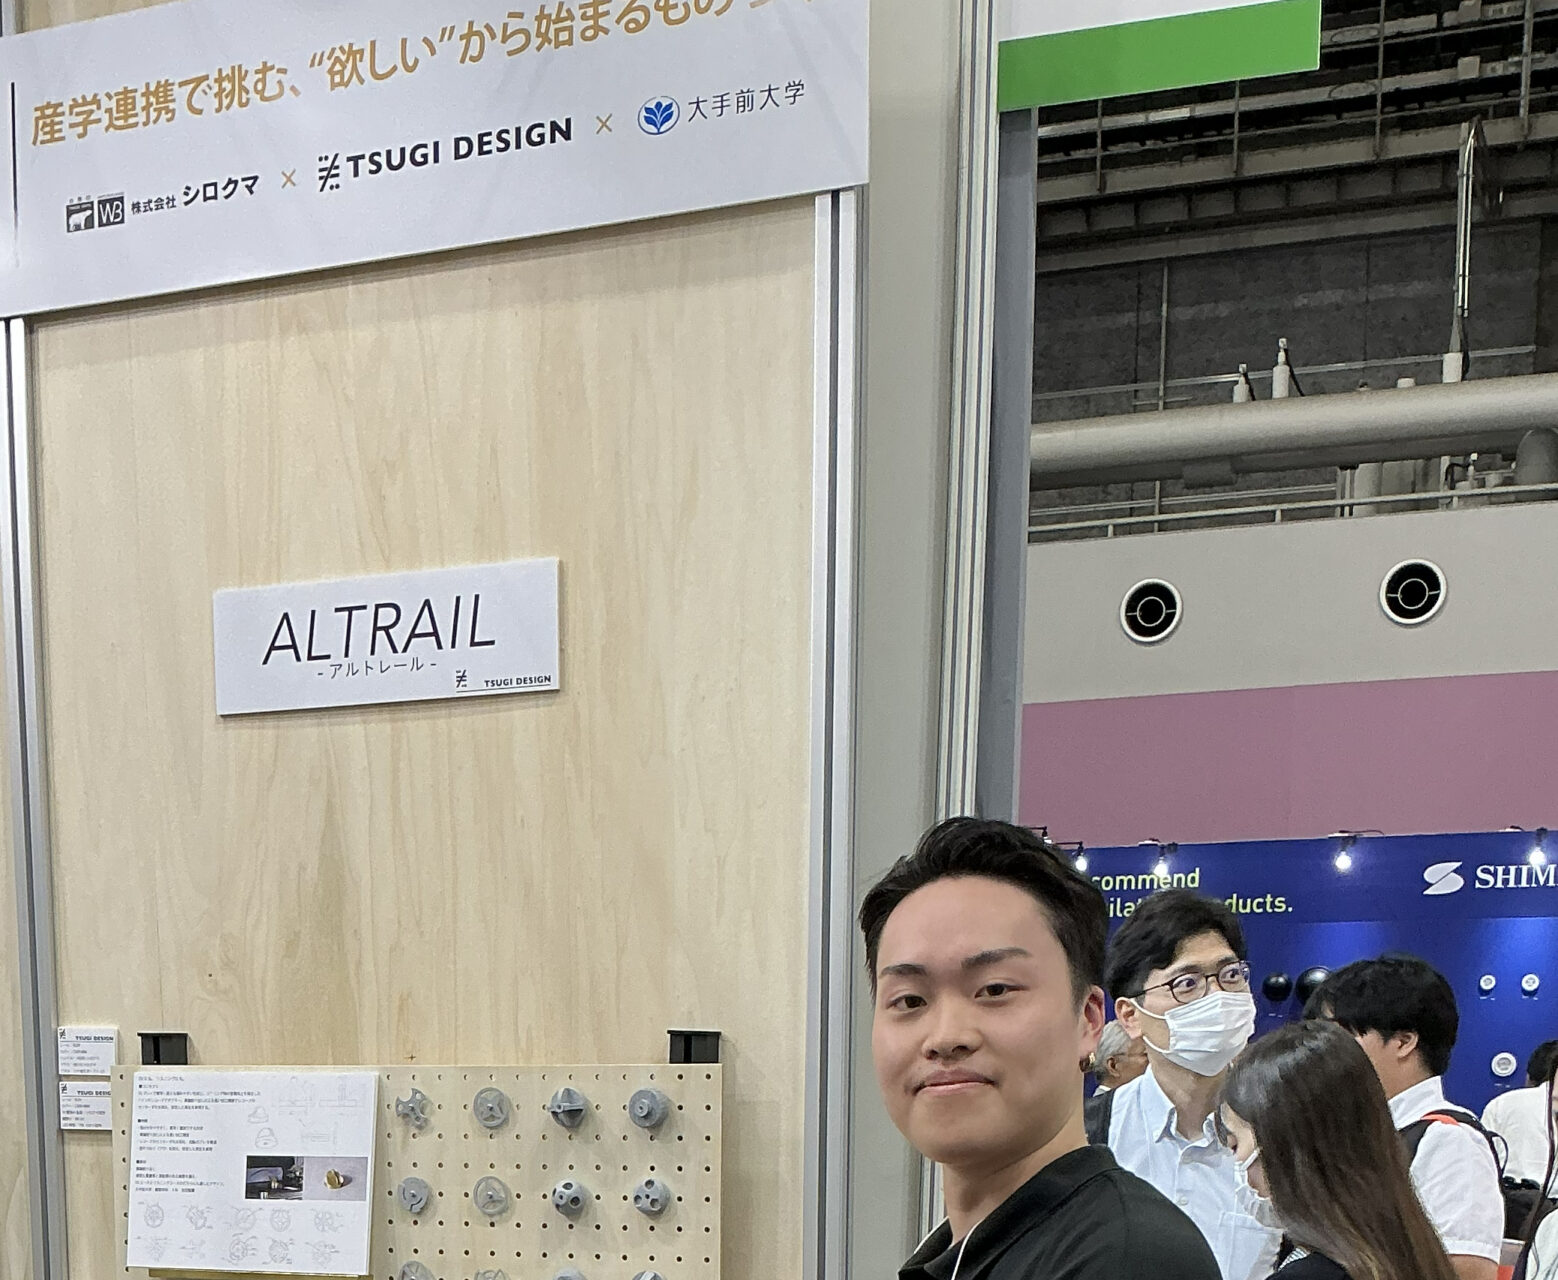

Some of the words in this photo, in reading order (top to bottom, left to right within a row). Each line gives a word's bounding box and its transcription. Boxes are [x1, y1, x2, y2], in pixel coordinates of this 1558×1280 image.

[687, 79, 805, 123] 大手前大学
[346, 140, 440, 179] TSUGI
[453, 117, 573, 162] DESIGN
[131, 195, 177, 215] 株式会社
[182, 174, 260, 207] シロクマ
[262, 593, 496, 666] ALTRAIL
[484, 677, 513, 688] TSUGI
[516, 674, 552, 686] DESIGN
[1474, 863, 1558, 889] SHIM
[1225, 893, 1293, 914] ducts.
